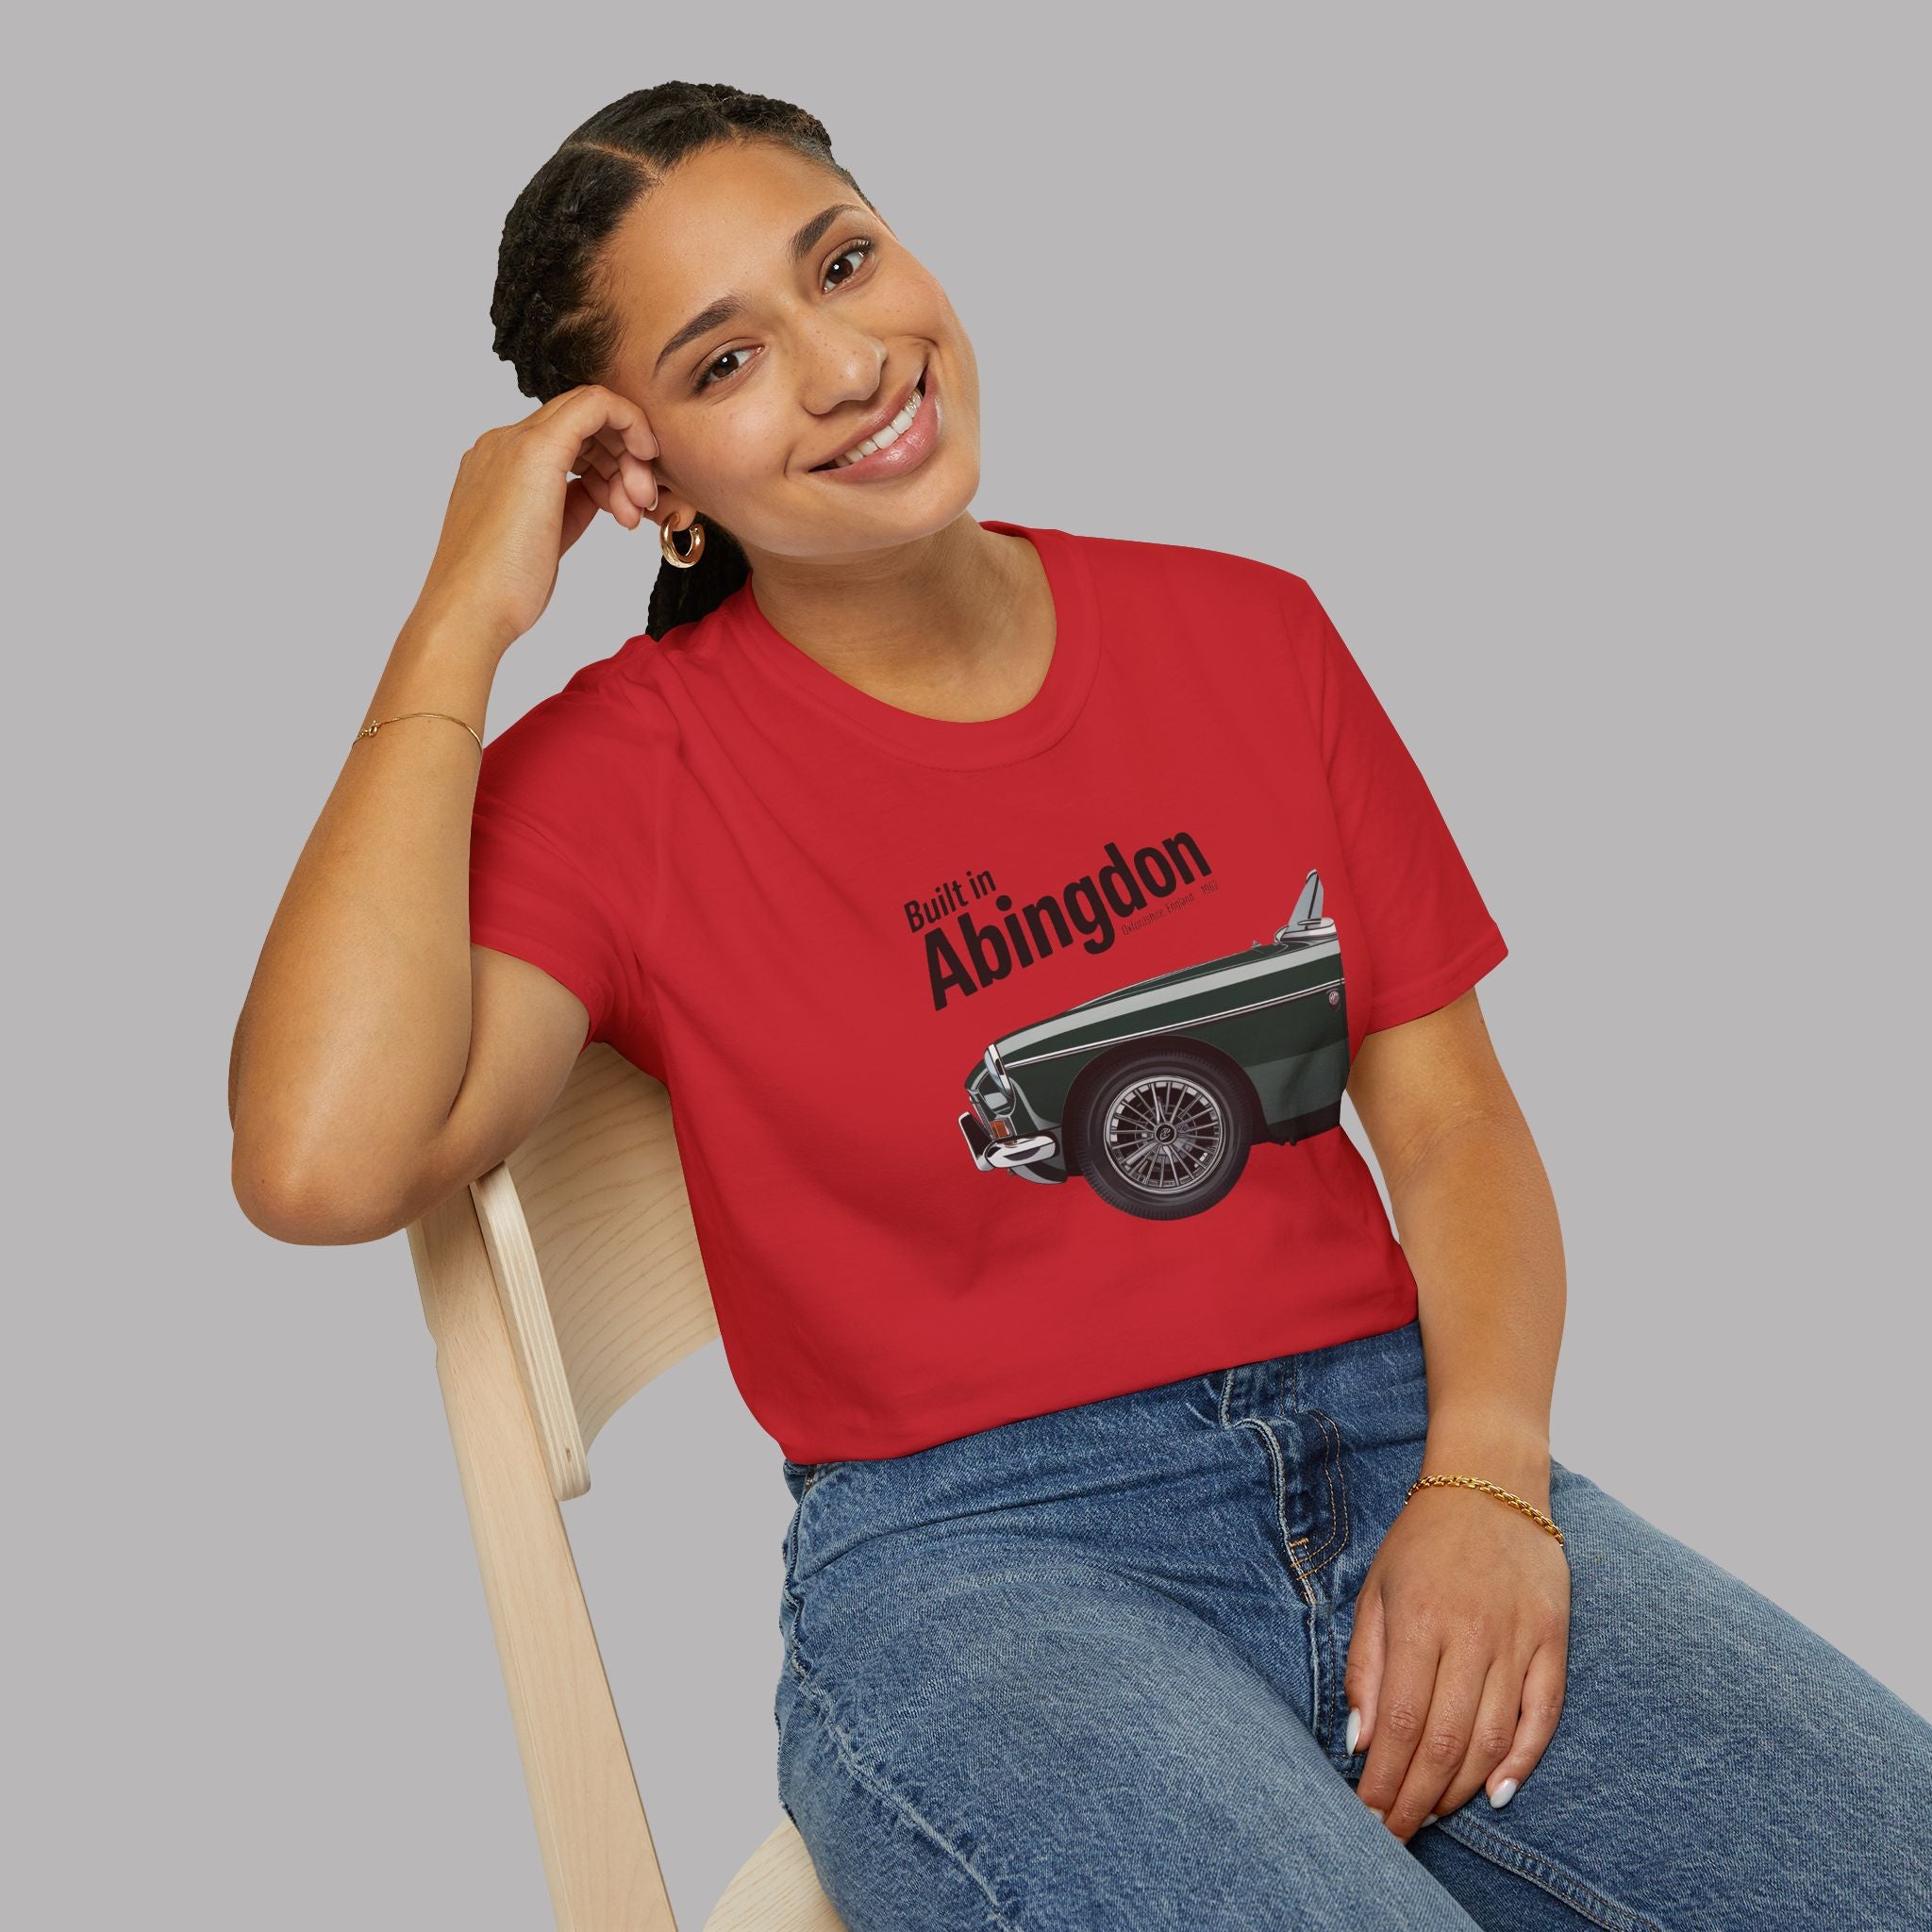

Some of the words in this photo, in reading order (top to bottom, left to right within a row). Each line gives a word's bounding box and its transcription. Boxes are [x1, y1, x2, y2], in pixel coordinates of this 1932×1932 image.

[905, 881, 969, 933] Built
[967, 870, 997, 900] in
[924, 832, 1212, 1010] Abingdon
